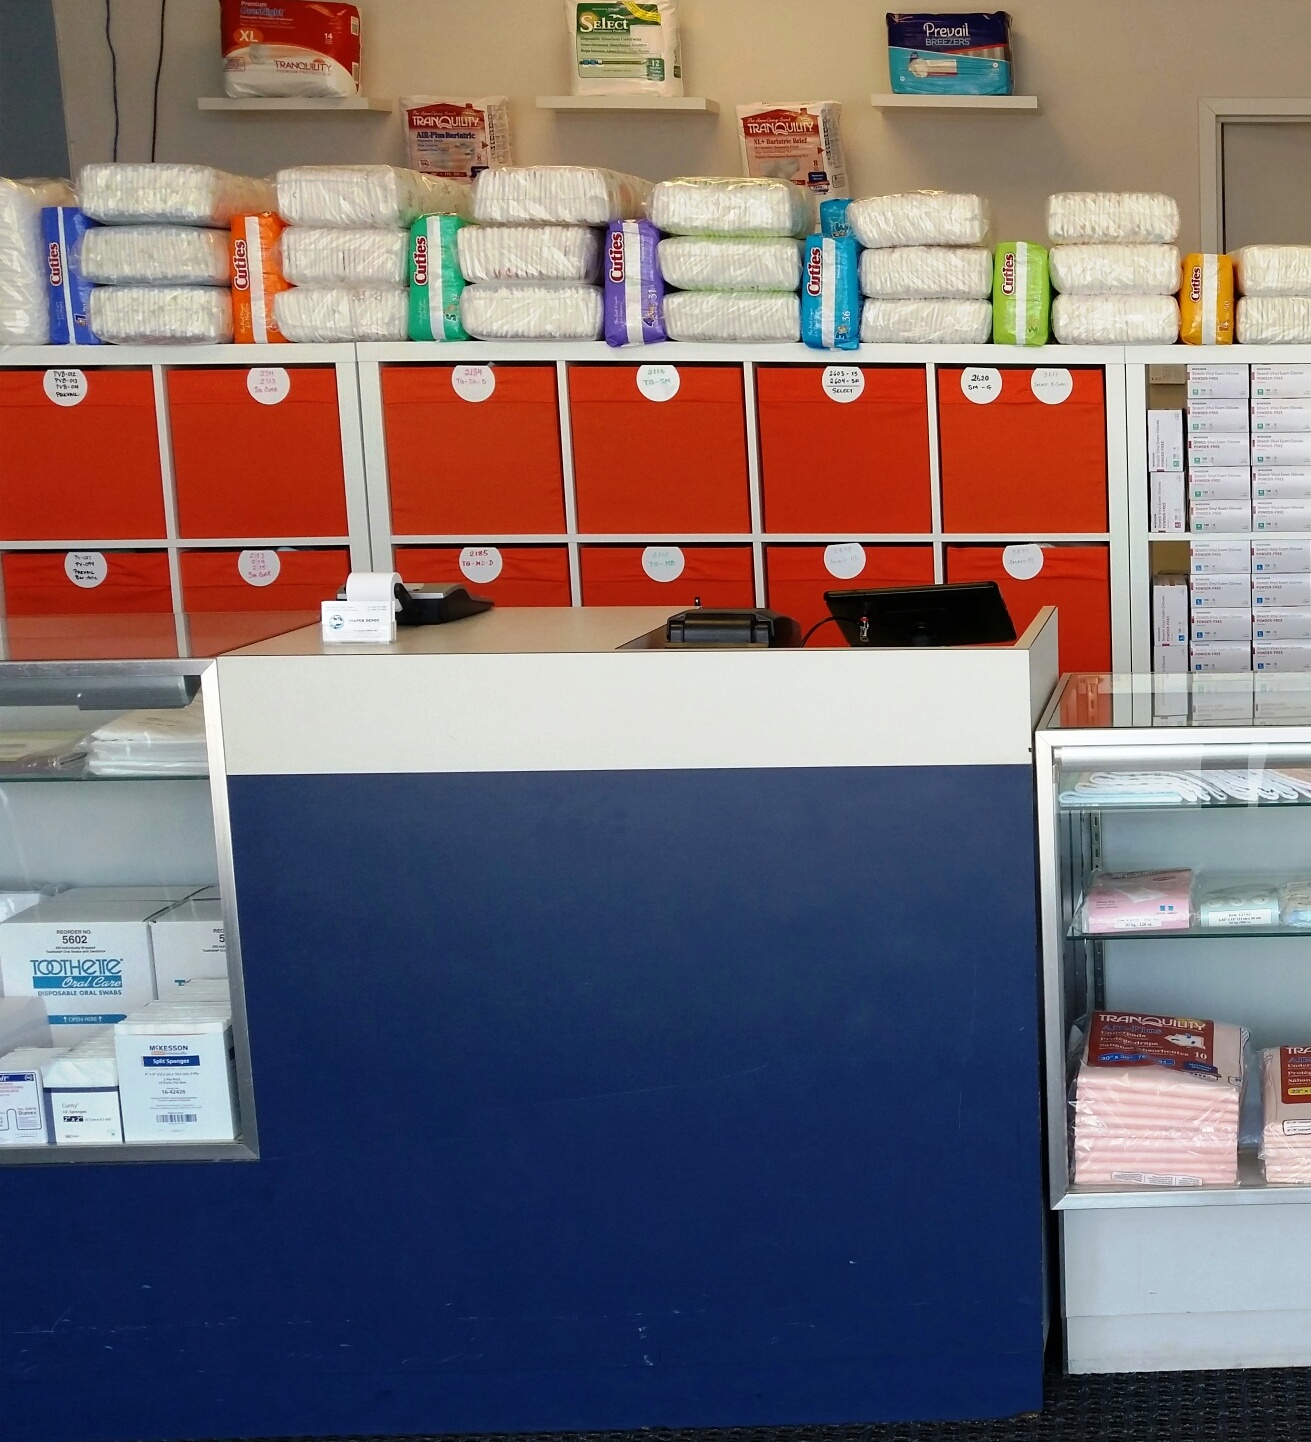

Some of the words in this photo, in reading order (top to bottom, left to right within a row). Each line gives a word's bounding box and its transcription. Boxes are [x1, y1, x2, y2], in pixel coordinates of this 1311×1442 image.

[239, 29, 259, 42] XL
[923, 22, 970, 37] Prevail
[925, 37, 971, 46] BREEZERS
[273, 60, 332, 72] TRANQUILITY
[411, 116, 480, 129] TRANQUILITY
[747, 121, 814, 136] TRANQUILITY
[49, 241, 60, 287] Cuties
[233, 238, 249, 291] Cuties
[413, 235, 427, 286] Cuties
[609, 231, 624, 283] Cuties
[805, 247, 822, 297] Cuties
[1001, 252, 1015, 296] Cuties
[1189, 266, 1201, 302] Cuties
[61, 935, 88, 944] 5602
[61, 976, 89, 988] Oral
[92, 976, 122, 988] Care
[1099, 1014, 1206, 1031] TRANQUILITY
[1194, 1051, 1208, 1060] 10
